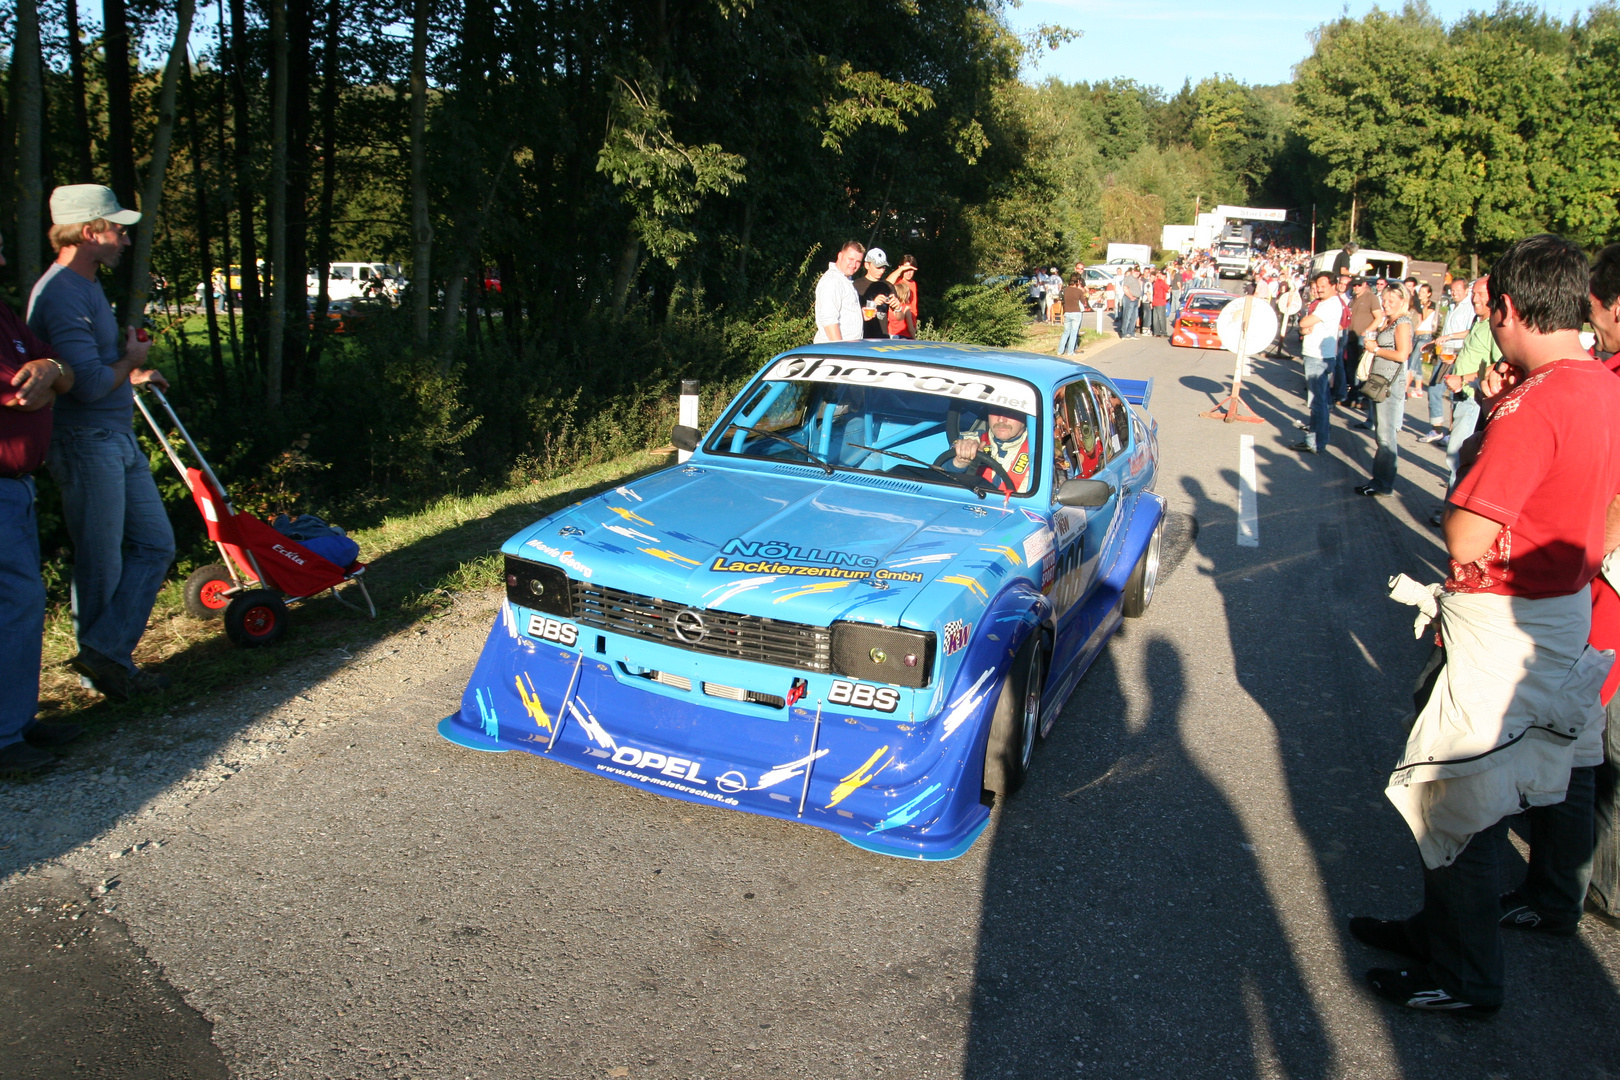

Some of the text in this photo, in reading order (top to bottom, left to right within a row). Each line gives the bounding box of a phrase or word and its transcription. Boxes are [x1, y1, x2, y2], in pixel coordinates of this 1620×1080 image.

[1014, 453, 1029, 474] OMP
[272, 544, 304, 566] Eckla
[559, 550, 593, 578] Georg
[721, 538, 880, 568] NÖLLING
[709, 557, 924, 583] Lackierzentrum GmbH
[527, 614, 579, 647] BBS
[947, 622, 973, 657] KW
[827, 679, 901, 713] BBS
[611, 746, 708, 785] OPEL
